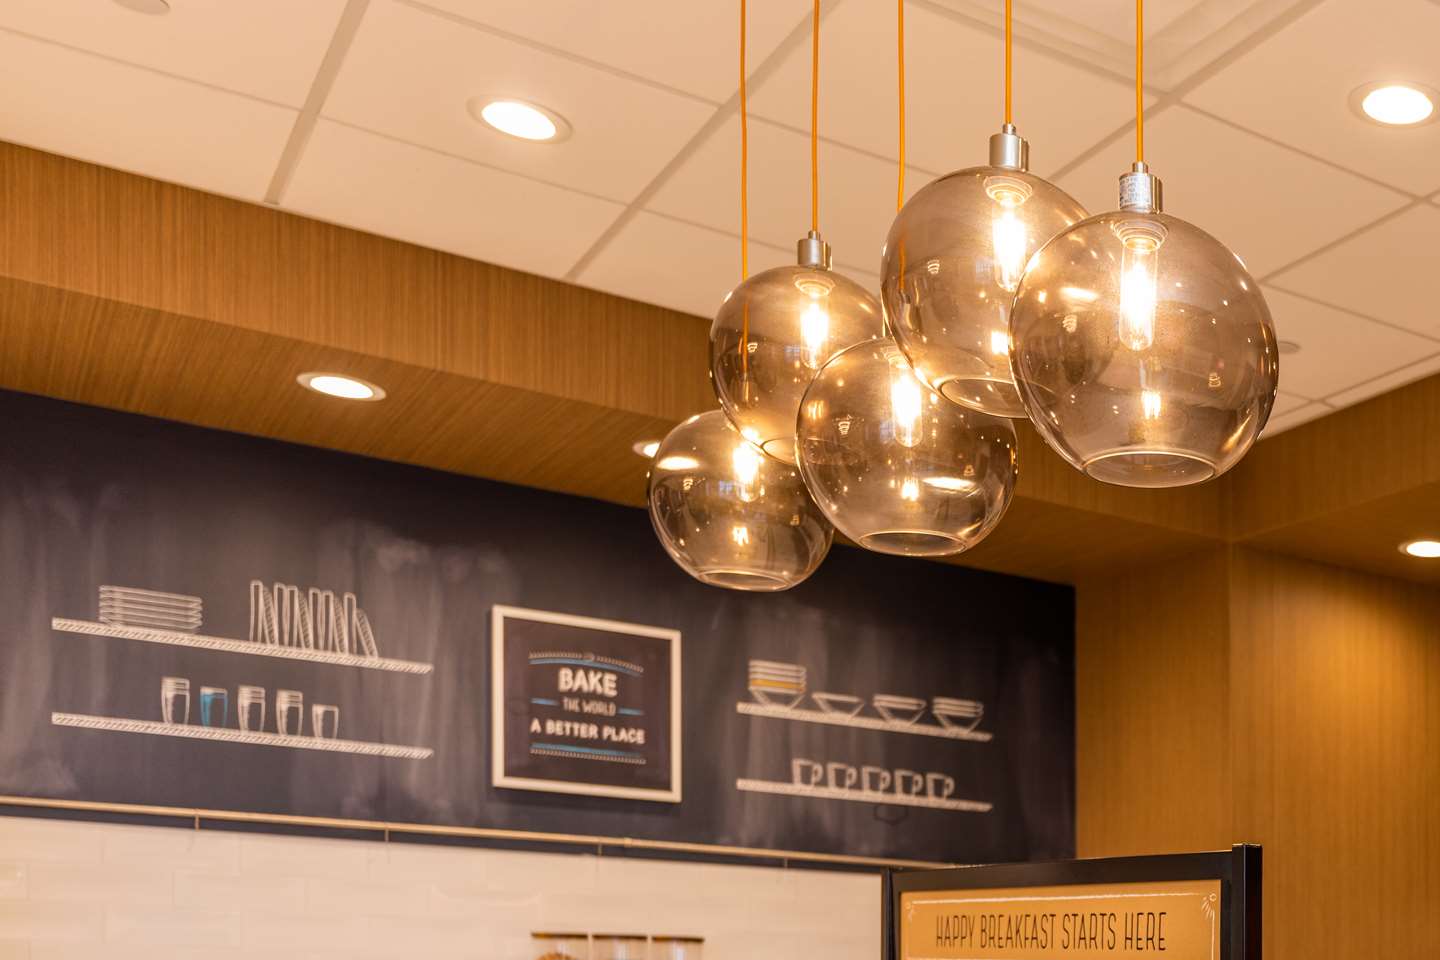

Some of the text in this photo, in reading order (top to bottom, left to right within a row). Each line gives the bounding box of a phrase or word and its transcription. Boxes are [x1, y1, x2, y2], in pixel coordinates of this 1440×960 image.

[559, 668, 618, 696] BAKE
[530, 718, 645, 744] A BETTER PLACE
[936, 911, 1167, 951] HAPPY BREAKFAST STARTS HERE
